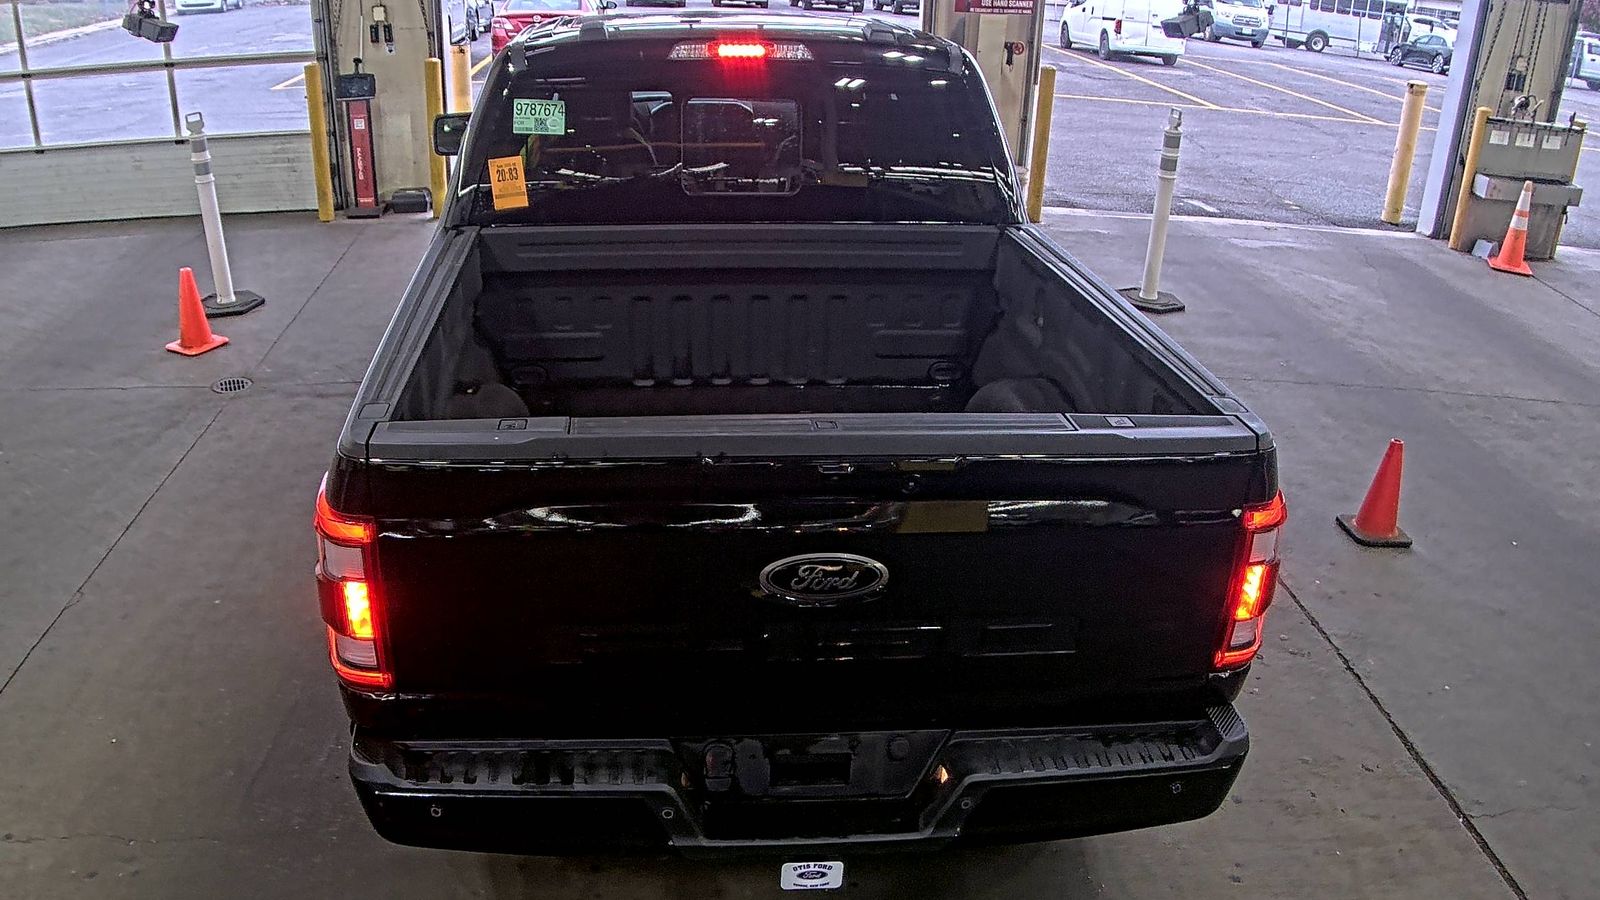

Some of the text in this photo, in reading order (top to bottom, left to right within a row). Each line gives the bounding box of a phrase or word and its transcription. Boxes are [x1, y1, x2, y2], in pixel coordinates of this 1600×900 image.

[1008, 0, 1033, 8] SCANNER
[515, 102, 566, 117] 9787674
[790, 564, 861, 590] Ford
